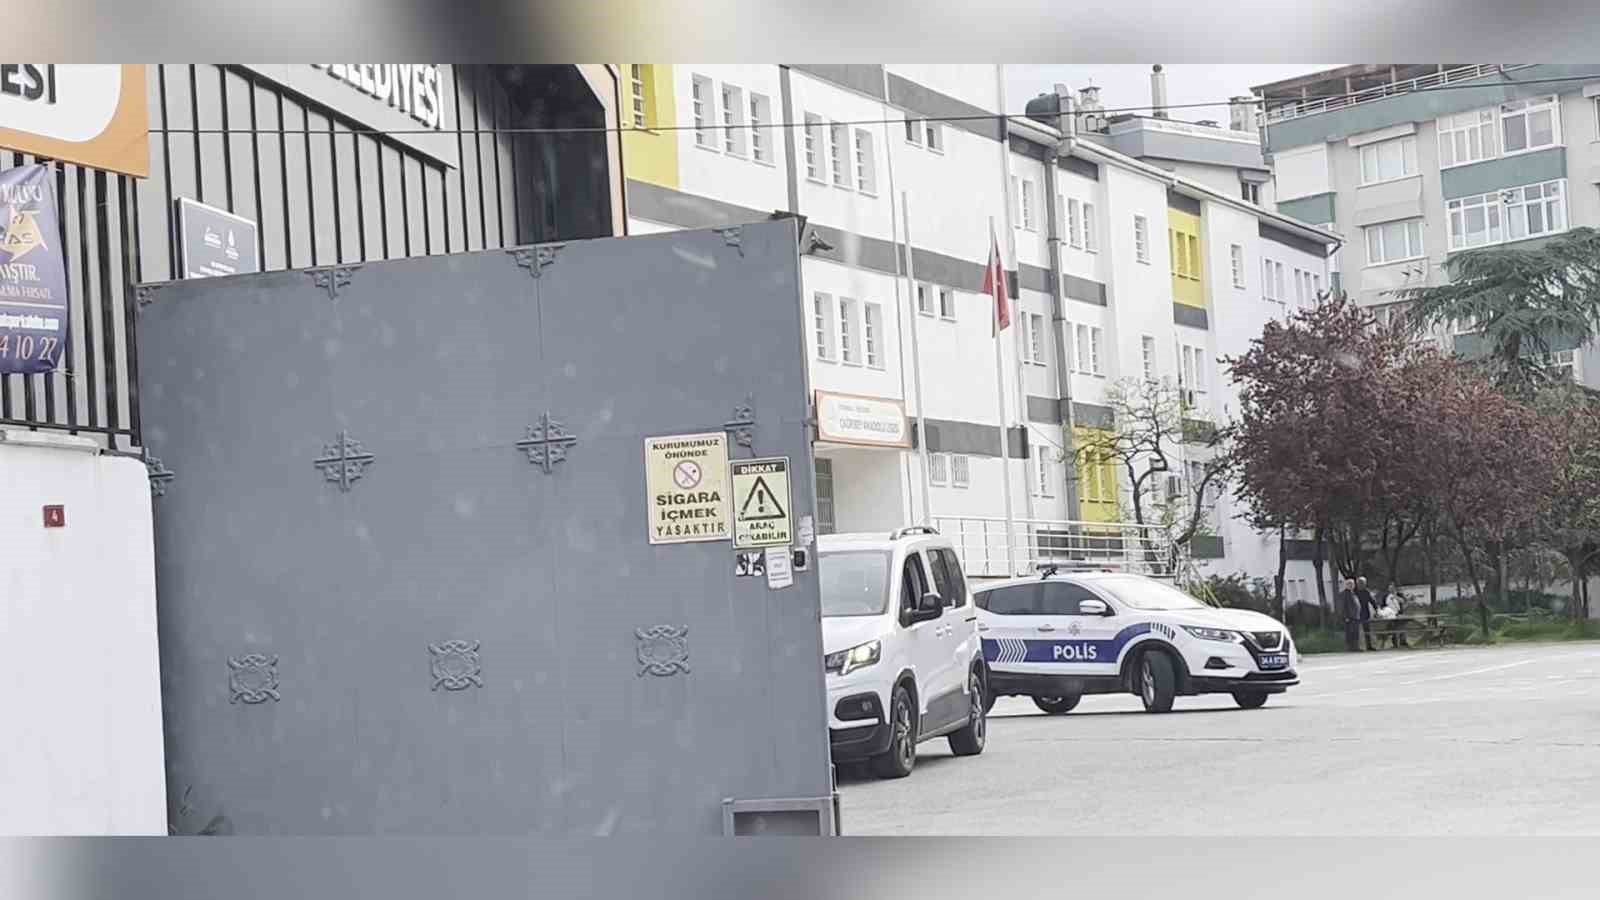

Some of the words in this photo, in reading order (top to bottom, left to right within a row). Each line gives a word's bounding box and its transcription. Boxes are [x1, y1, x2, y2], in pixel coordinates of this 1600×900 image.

[15, 335, 34, 359] 10
[38, 336, 58, 362] 27
[653, 439, 719, 450] KURUMUMUZ
[664, 449, 708, 460] ÖNÜNDE
[656, 491, 721, 506] SİGARA
[661, 508, 717, 522] İÇMEK
[656, 522, 725, 537] YASAKTIR
[1053, 642, 1097, 660] POLİS
